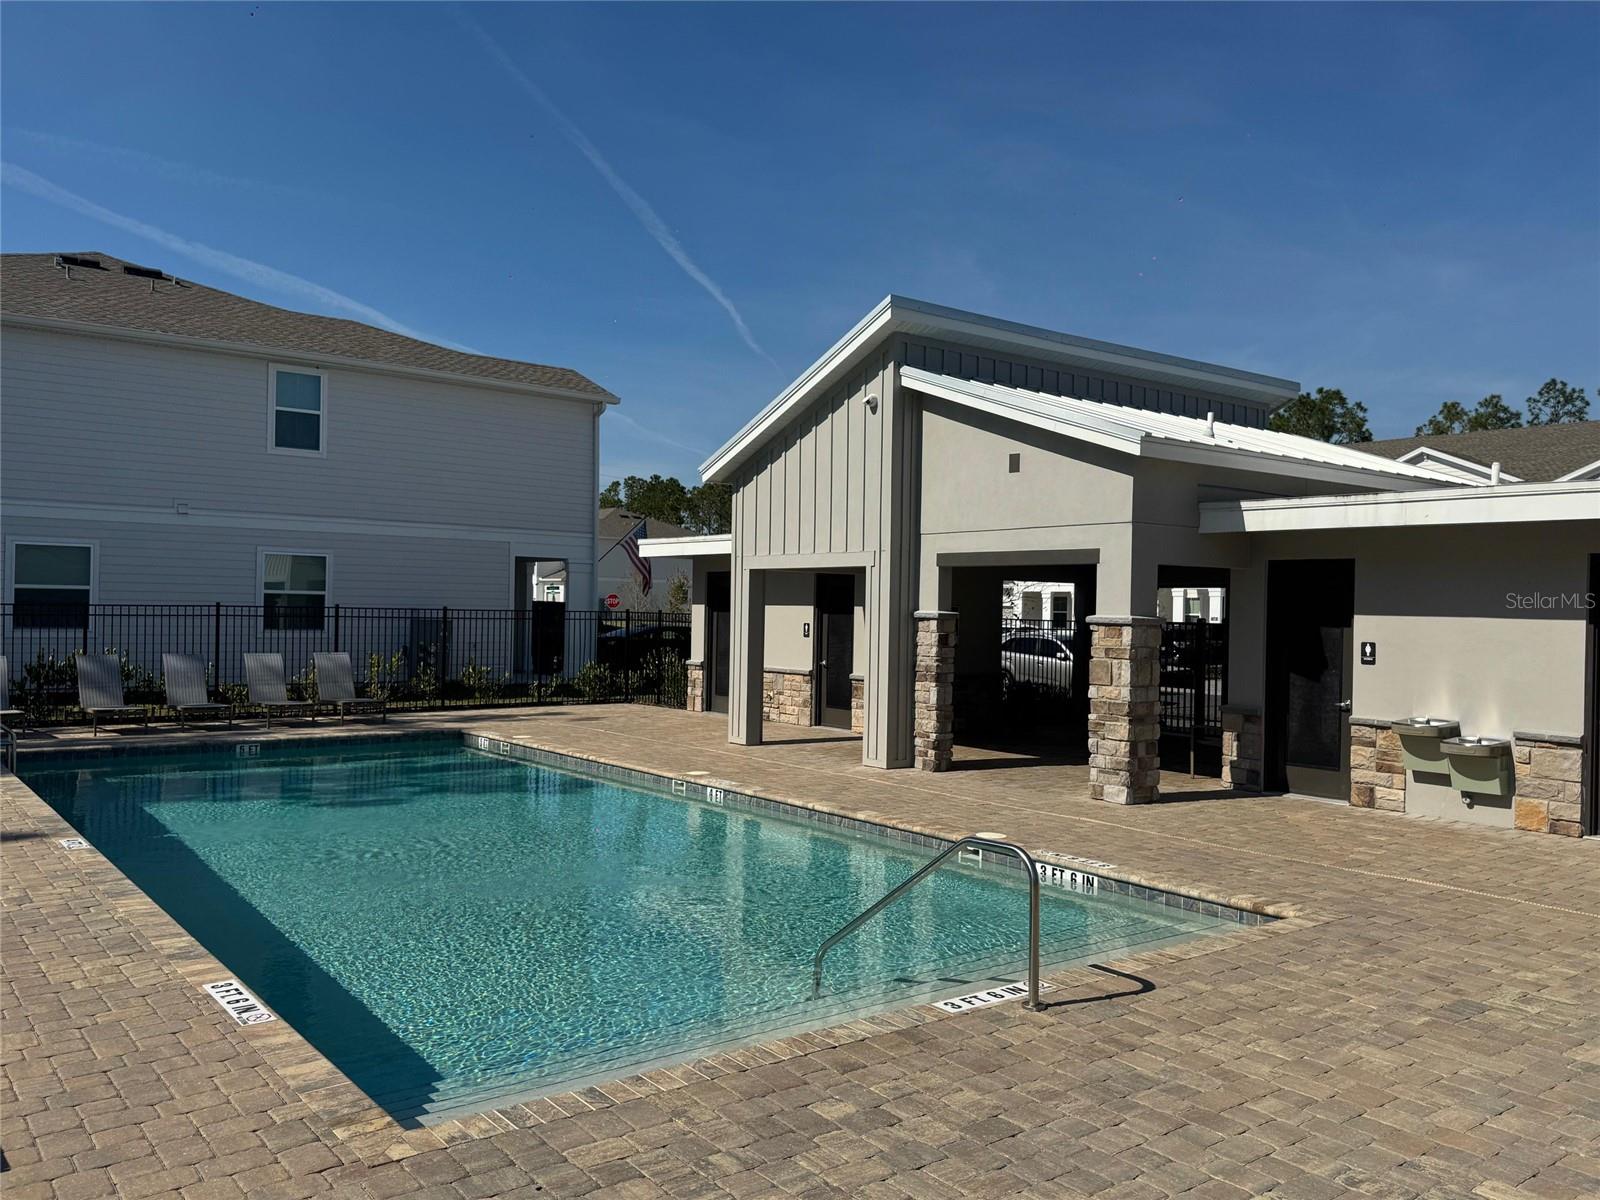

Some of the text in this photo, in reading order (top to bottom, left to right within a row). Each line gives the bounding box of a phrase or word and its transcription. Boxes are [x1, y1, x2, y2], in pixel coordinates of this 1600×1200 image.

[606, 597, 619, 605] STOP
[1040, 864, 1095, 887] 3 FT 6 IN
[226, 997, 250, 1005] 6
[943, 1001, 962, 1010] 3
[986, 991, 1005, 999] 6
